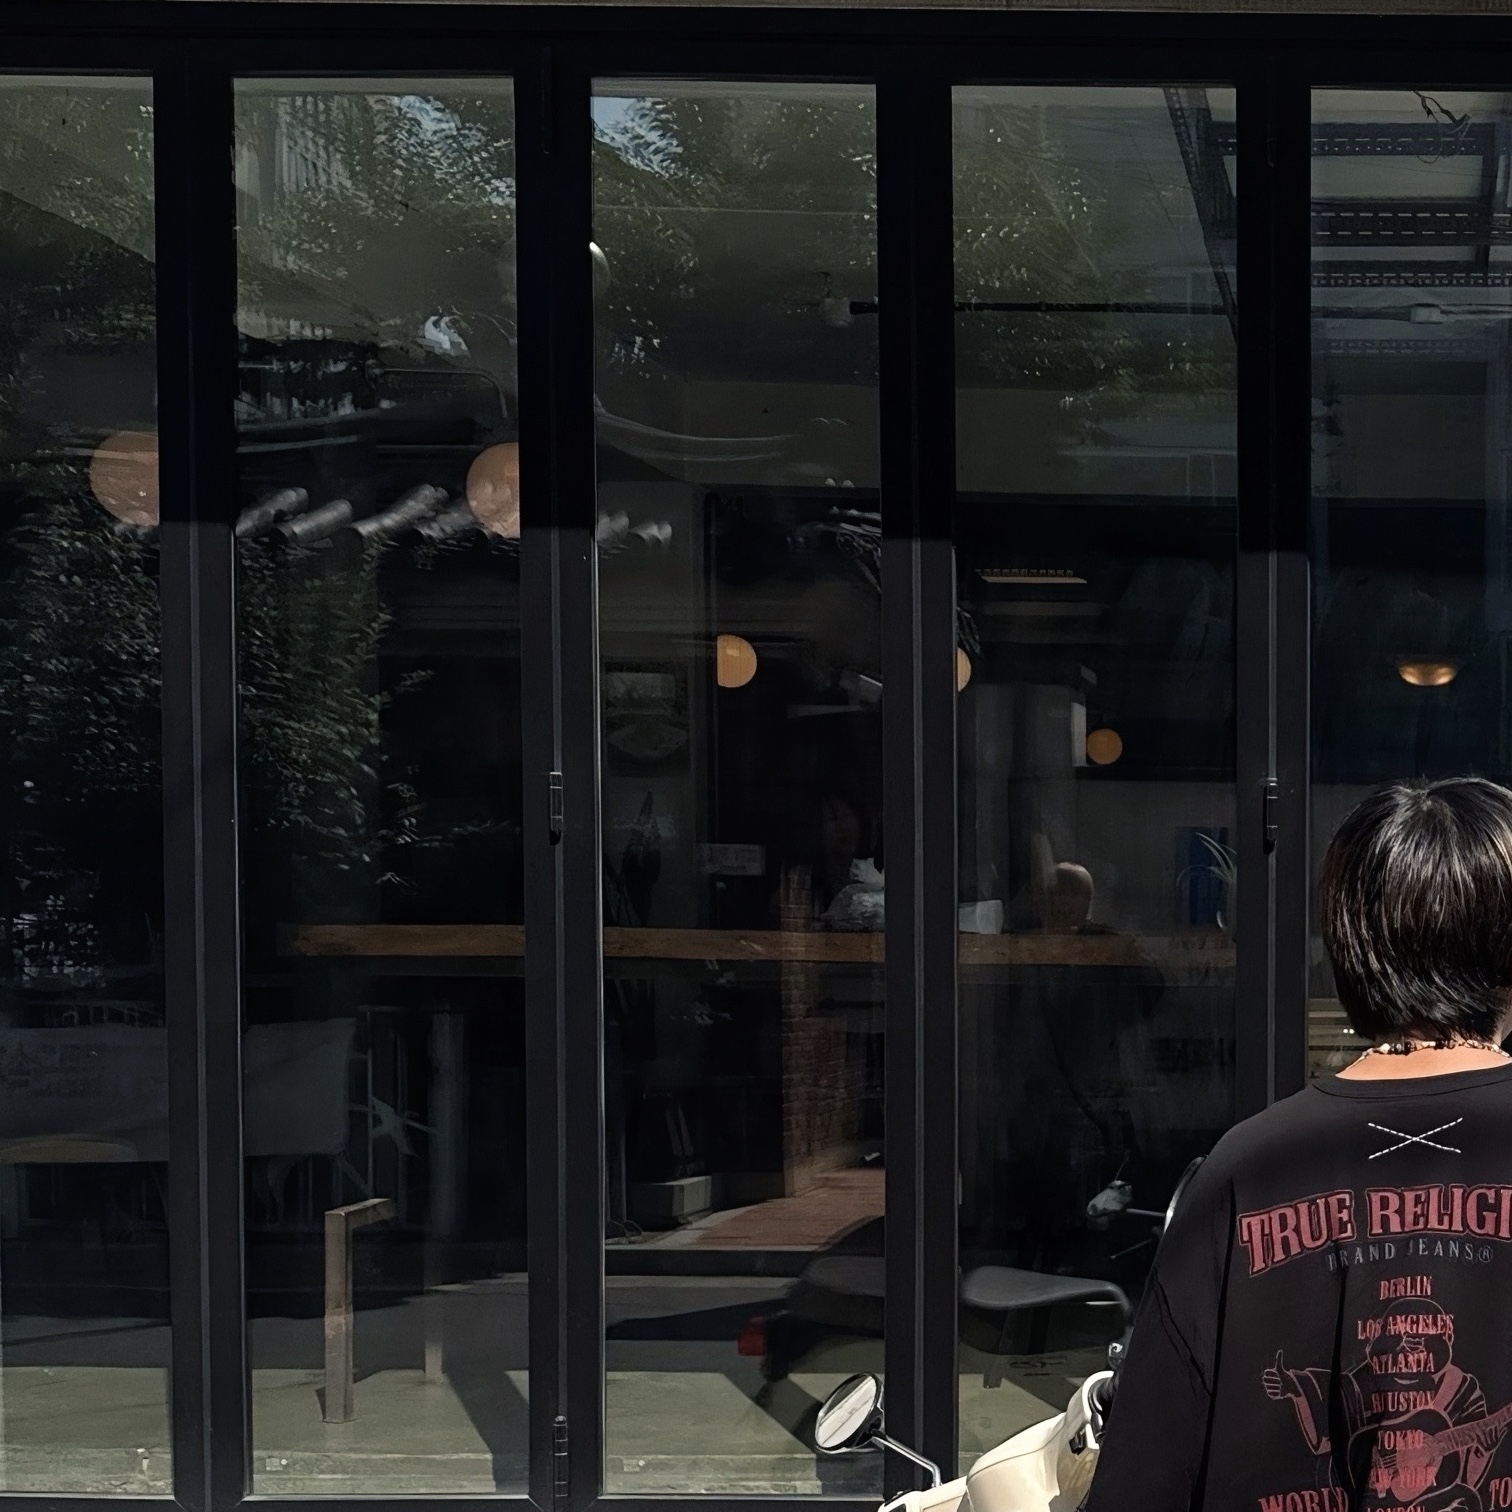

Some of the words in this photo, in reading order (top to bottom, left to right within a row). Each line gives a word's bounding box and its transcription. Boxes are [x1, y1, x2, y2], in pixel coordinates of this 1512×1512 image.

[1238, 1188, 1356, 1277] TRUE
[1379, 1275, 1432, 1300] BERLIN
[1372, 1351, 1434, 1374] ATLANTA
[1371, 1390, 1436, 1413] HUSTON
